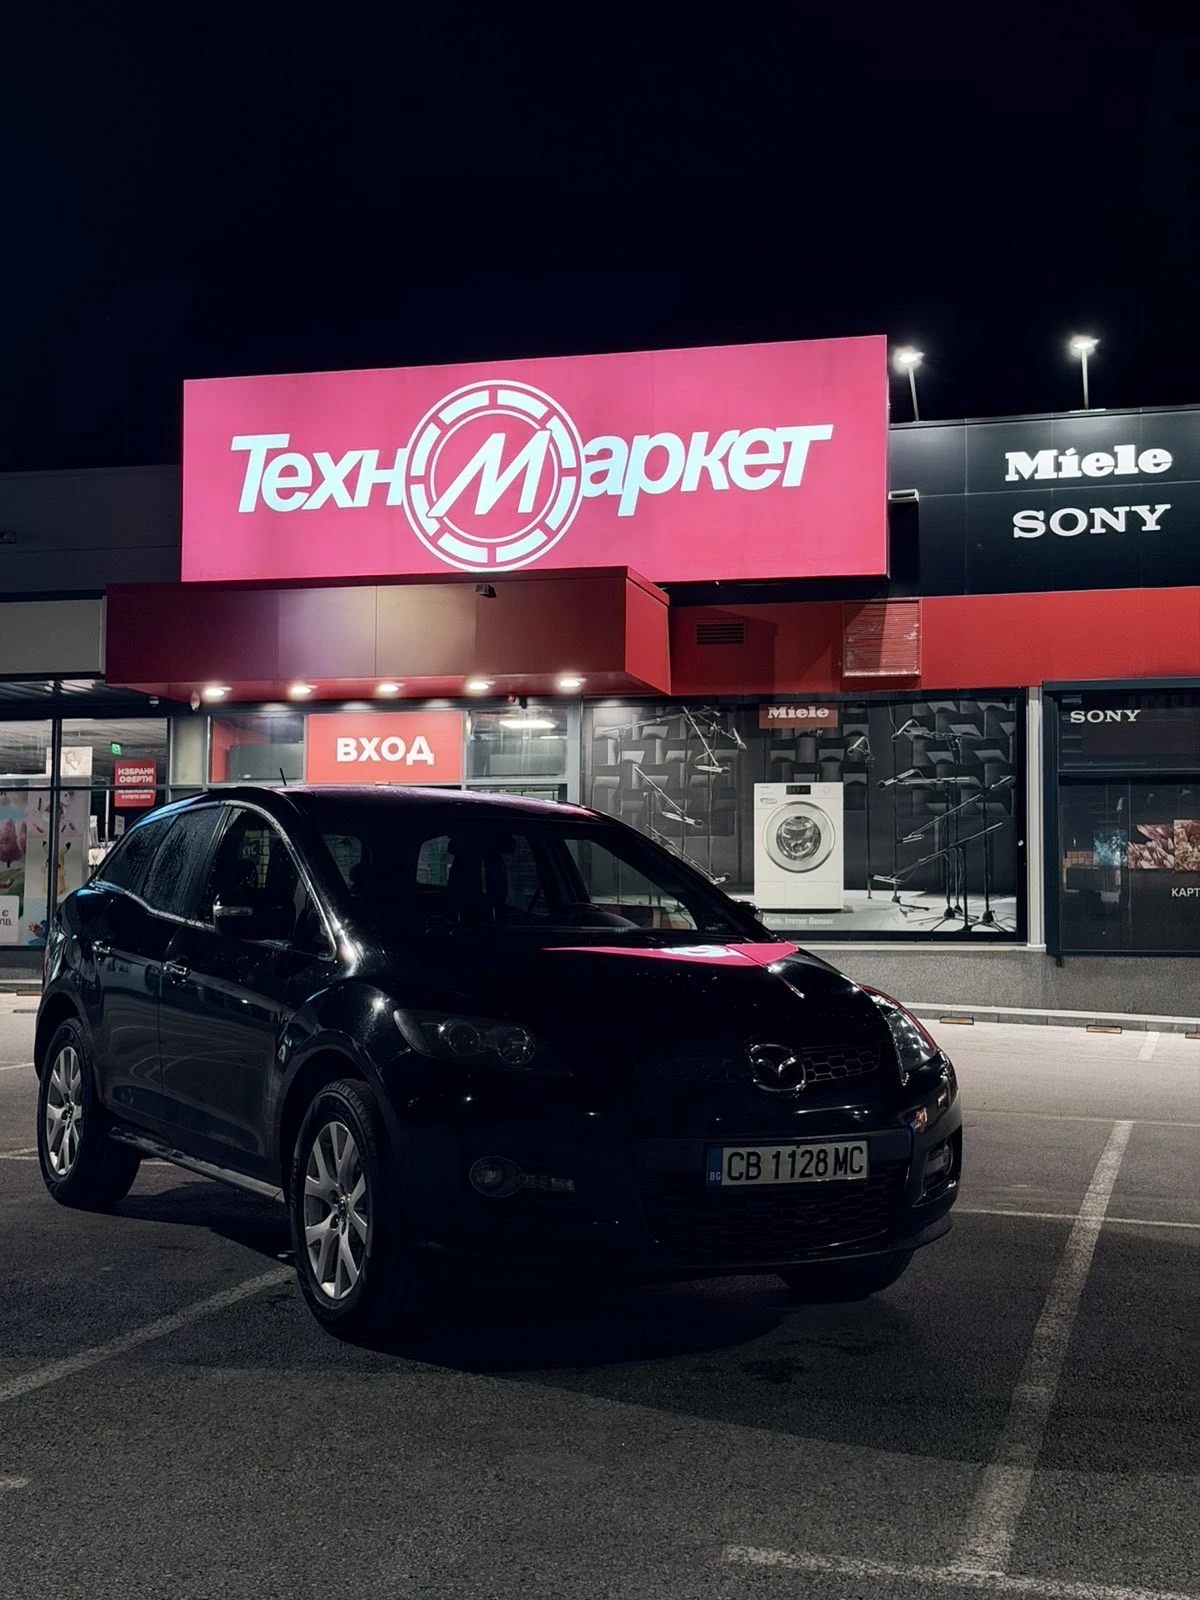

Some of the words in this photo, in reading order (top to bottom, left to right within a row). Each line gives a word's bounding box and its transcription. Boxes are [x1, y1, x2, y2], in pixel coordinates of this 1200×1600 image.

[1004, 444, 1173, 482] Miele
[1013, 504, 1171, 539] SONY
[767, 705, 830, 719] Miele
[1069, 709, 1142, 724] SONY
[336, 735, 435, 766] ВХОД
[785, 917, 807, 925] Immer
[727, 1151, 762, 1181] CB
[772, 1148, 829, 1179] 1128
[833, 1146, 864, 1176] MC
[709, 1171, 721, 1181] BG
